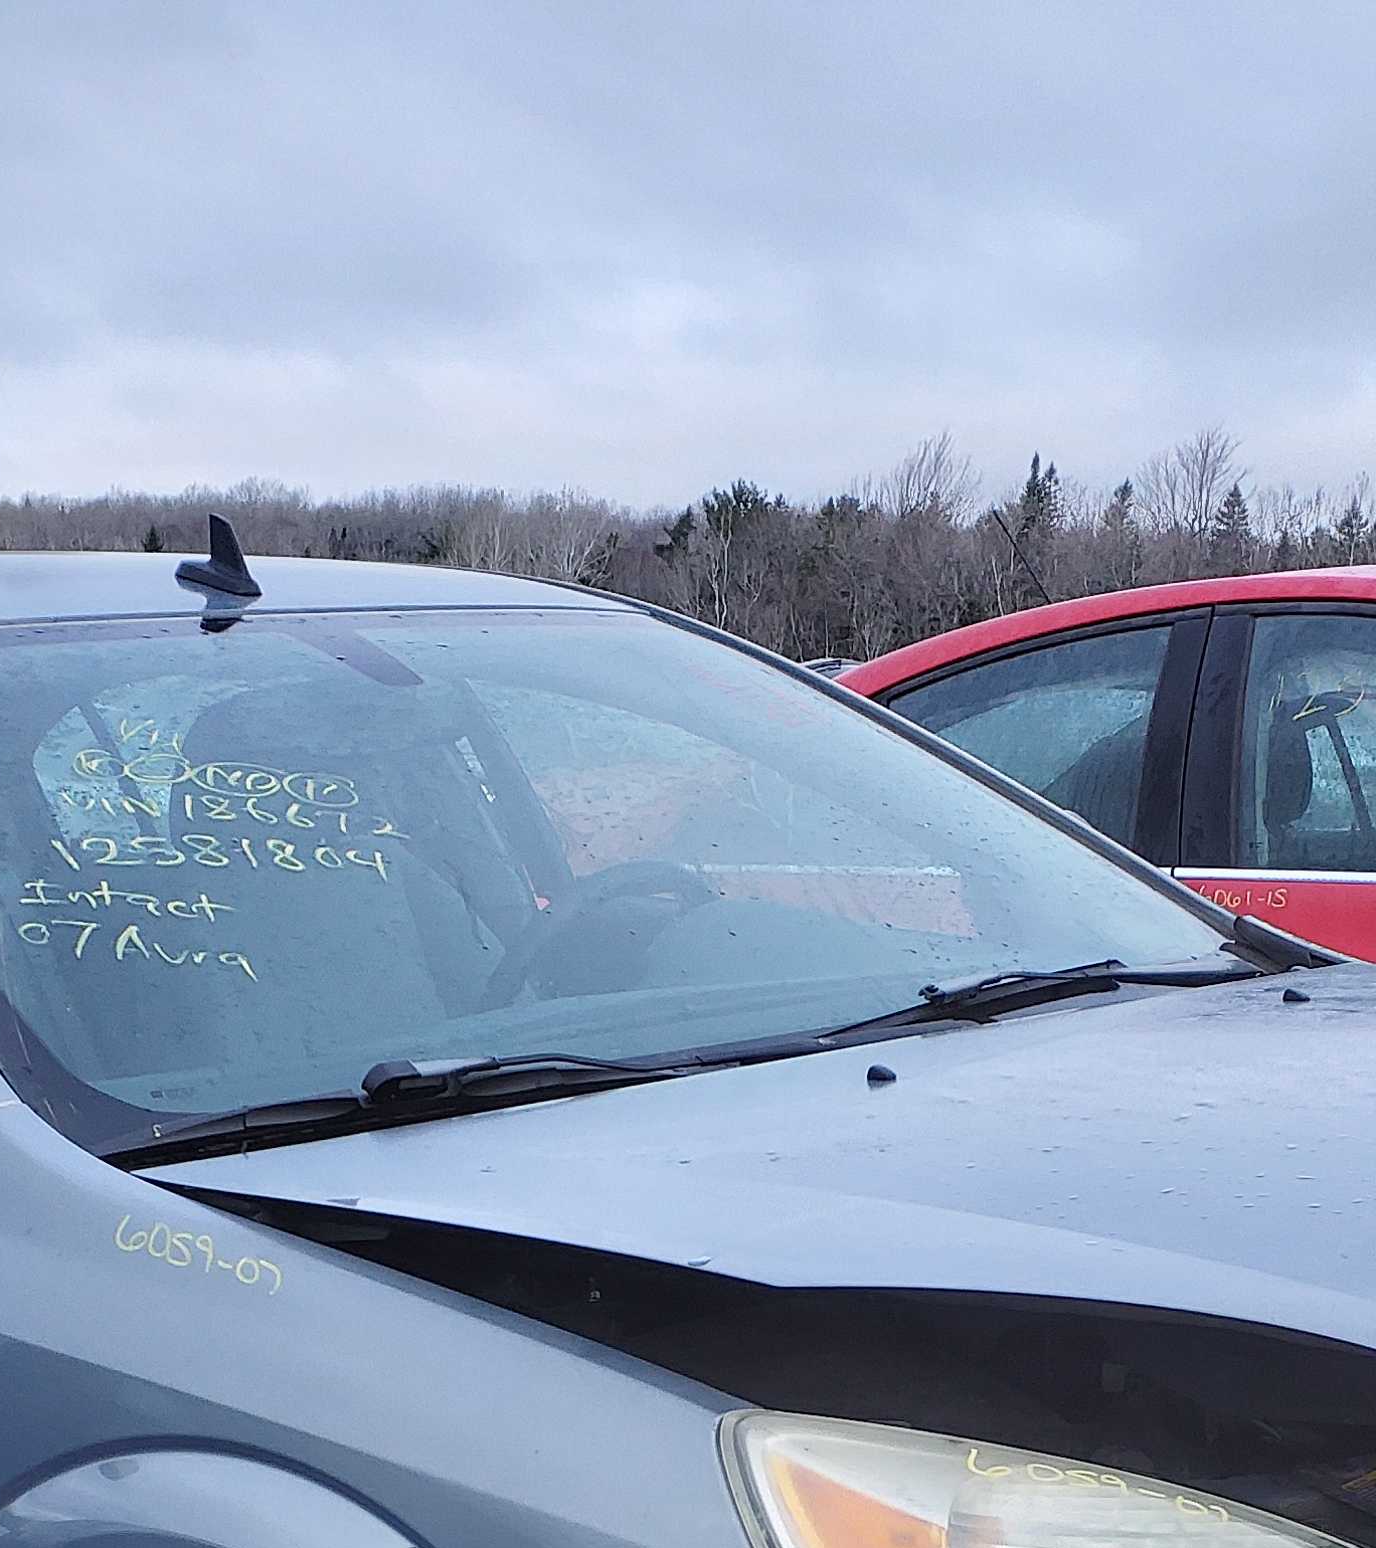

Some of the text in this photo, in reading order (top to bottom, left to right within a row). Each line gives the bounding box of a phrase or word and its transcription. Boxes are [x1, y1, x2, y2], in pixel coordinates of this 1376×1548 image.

[19, 878, 235, 923] Intact
[17, 919, 102, 961] 07
[114, 1214, 283, 1296] 6059-07
[966, 1448, 1230, 1522] 6059-07
